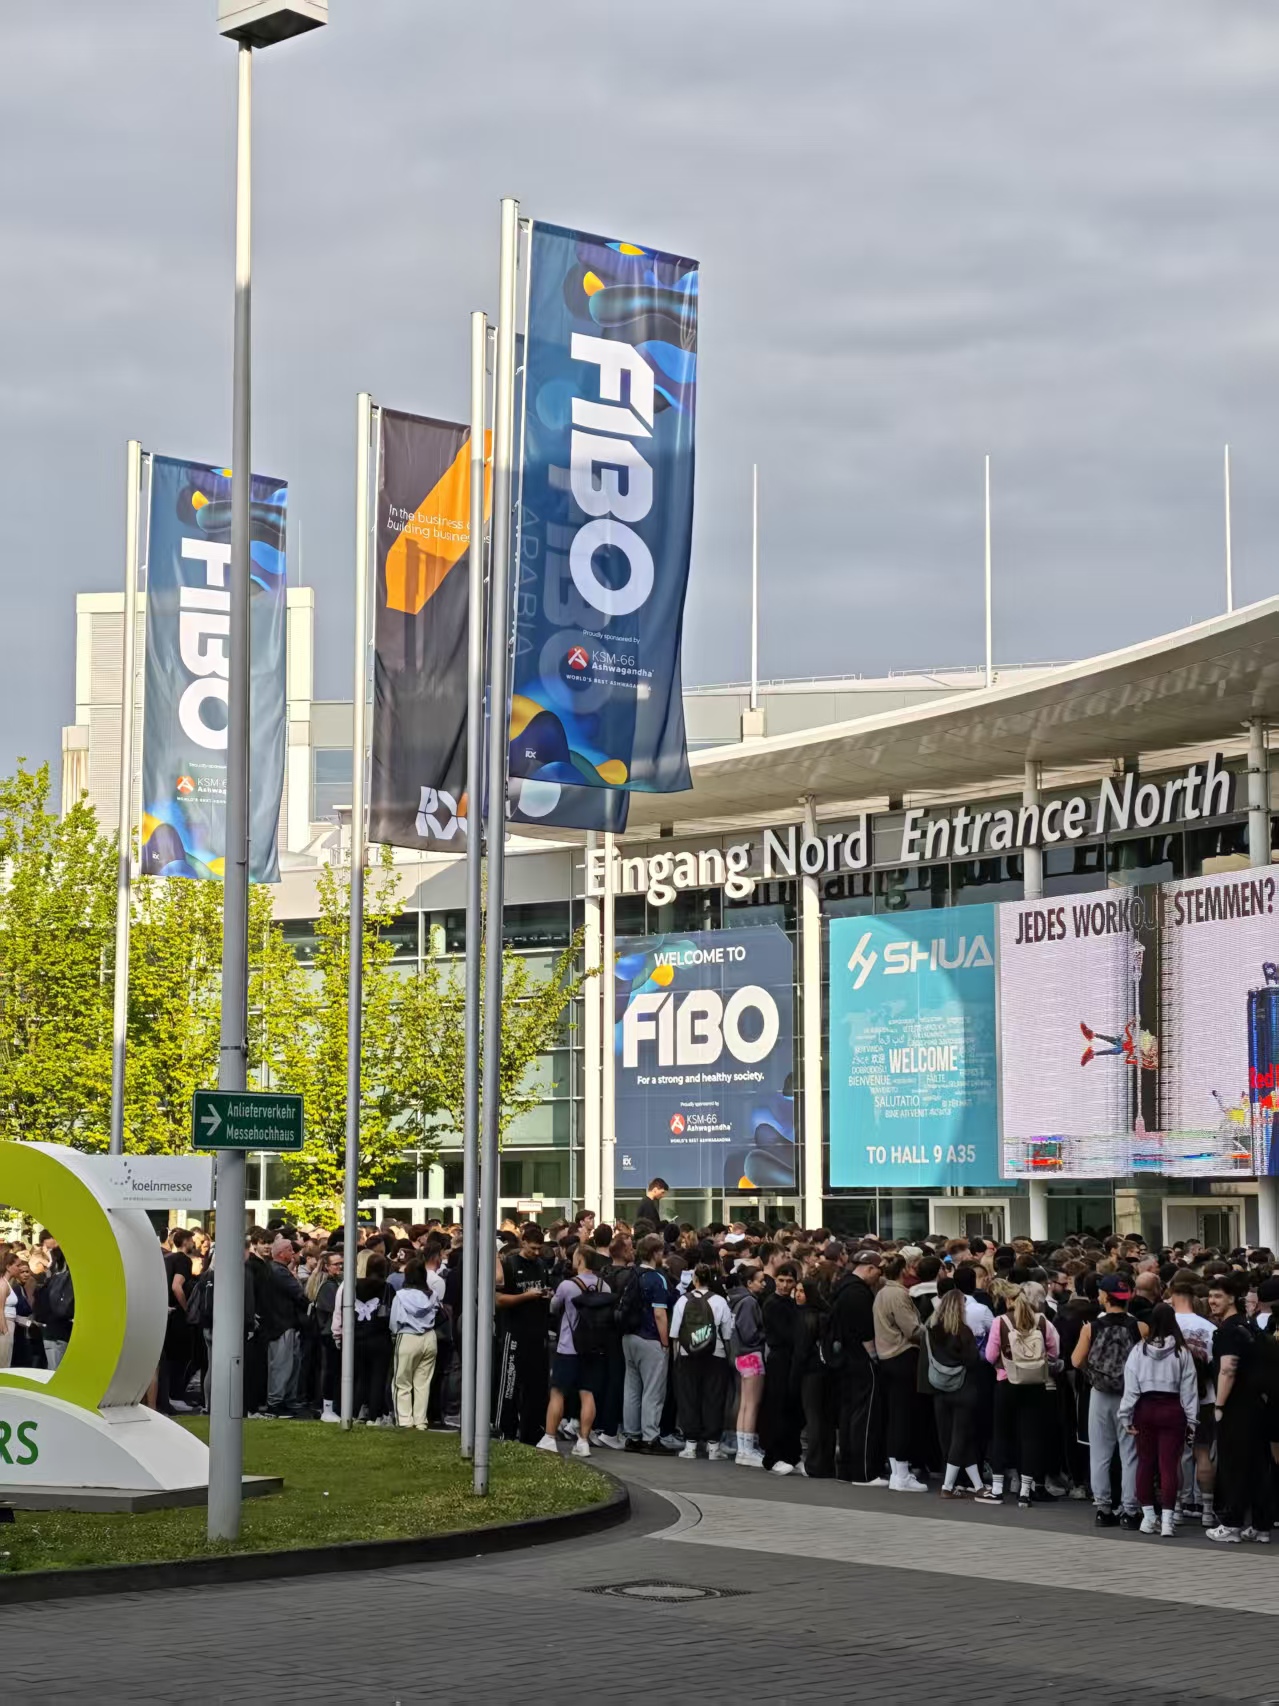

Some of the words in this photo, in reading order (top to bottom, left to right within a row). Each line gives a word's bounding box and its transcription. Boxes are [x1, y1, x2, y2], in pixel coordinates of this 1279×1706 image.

[570, 332, 655, 616] FIBO
[389, 504, 398, 516] In
[400, 508, 415, 521] the
[418, 512, 463, 530] business
[387, 517, 430, 537] building
[582, 629, 603, 639] Proudly
[604, 634, 632, 643] sponsored
[592, 650, 635, 666] KSM-66
[566, 674, 592, 683] WORLD'S
[592, 661, 653, 677] Ashwagandha
[586, 843, 755, 906] Eingang
[763, 813, 870, 878] Nord
[900, 797, 1088, 862] Entrance
[1096, 752, 1232, 834] North
[1016, 906, 1067, 945] JEDES
[1072, 892, 1168, 938] WORKOUT
[1174, 877, 1276, 927] STEMMEN?
[654, 947, 724, 967] WELCOME
[727, 946, 746, 961] TO
[883, 935, 994, 974] SHUA
[623, 985, 780, 1068] FIBO
[889, 1045, 959, 1074] WELCOME
[637, 1076, 650, 1085] For
[657, 1074, 684, 1086] strong
[685, 1073, 700, 1083] and
[702, 1072, 732, 1084] healthy
[733, 1070, 765, 1081] society.
[848, 1074, 891, 1087] BIENVENUE
[1249, 1063, 1274, 1089] Red
[227, 1101, 296, 1119] Anlieferverkehr
[687, 1114, 717, 1124] KSM-66
[226, 1124, 295, 1141] Messehochhaus
[867, 1146, 886, 1163] TO
[891, 1146, 929, 1163] HALL
[933, 1145, 943, 1163] 9
[946, 1144, 976, 1163] A35
[132, 1179, 193, 1192] koelnmesse
